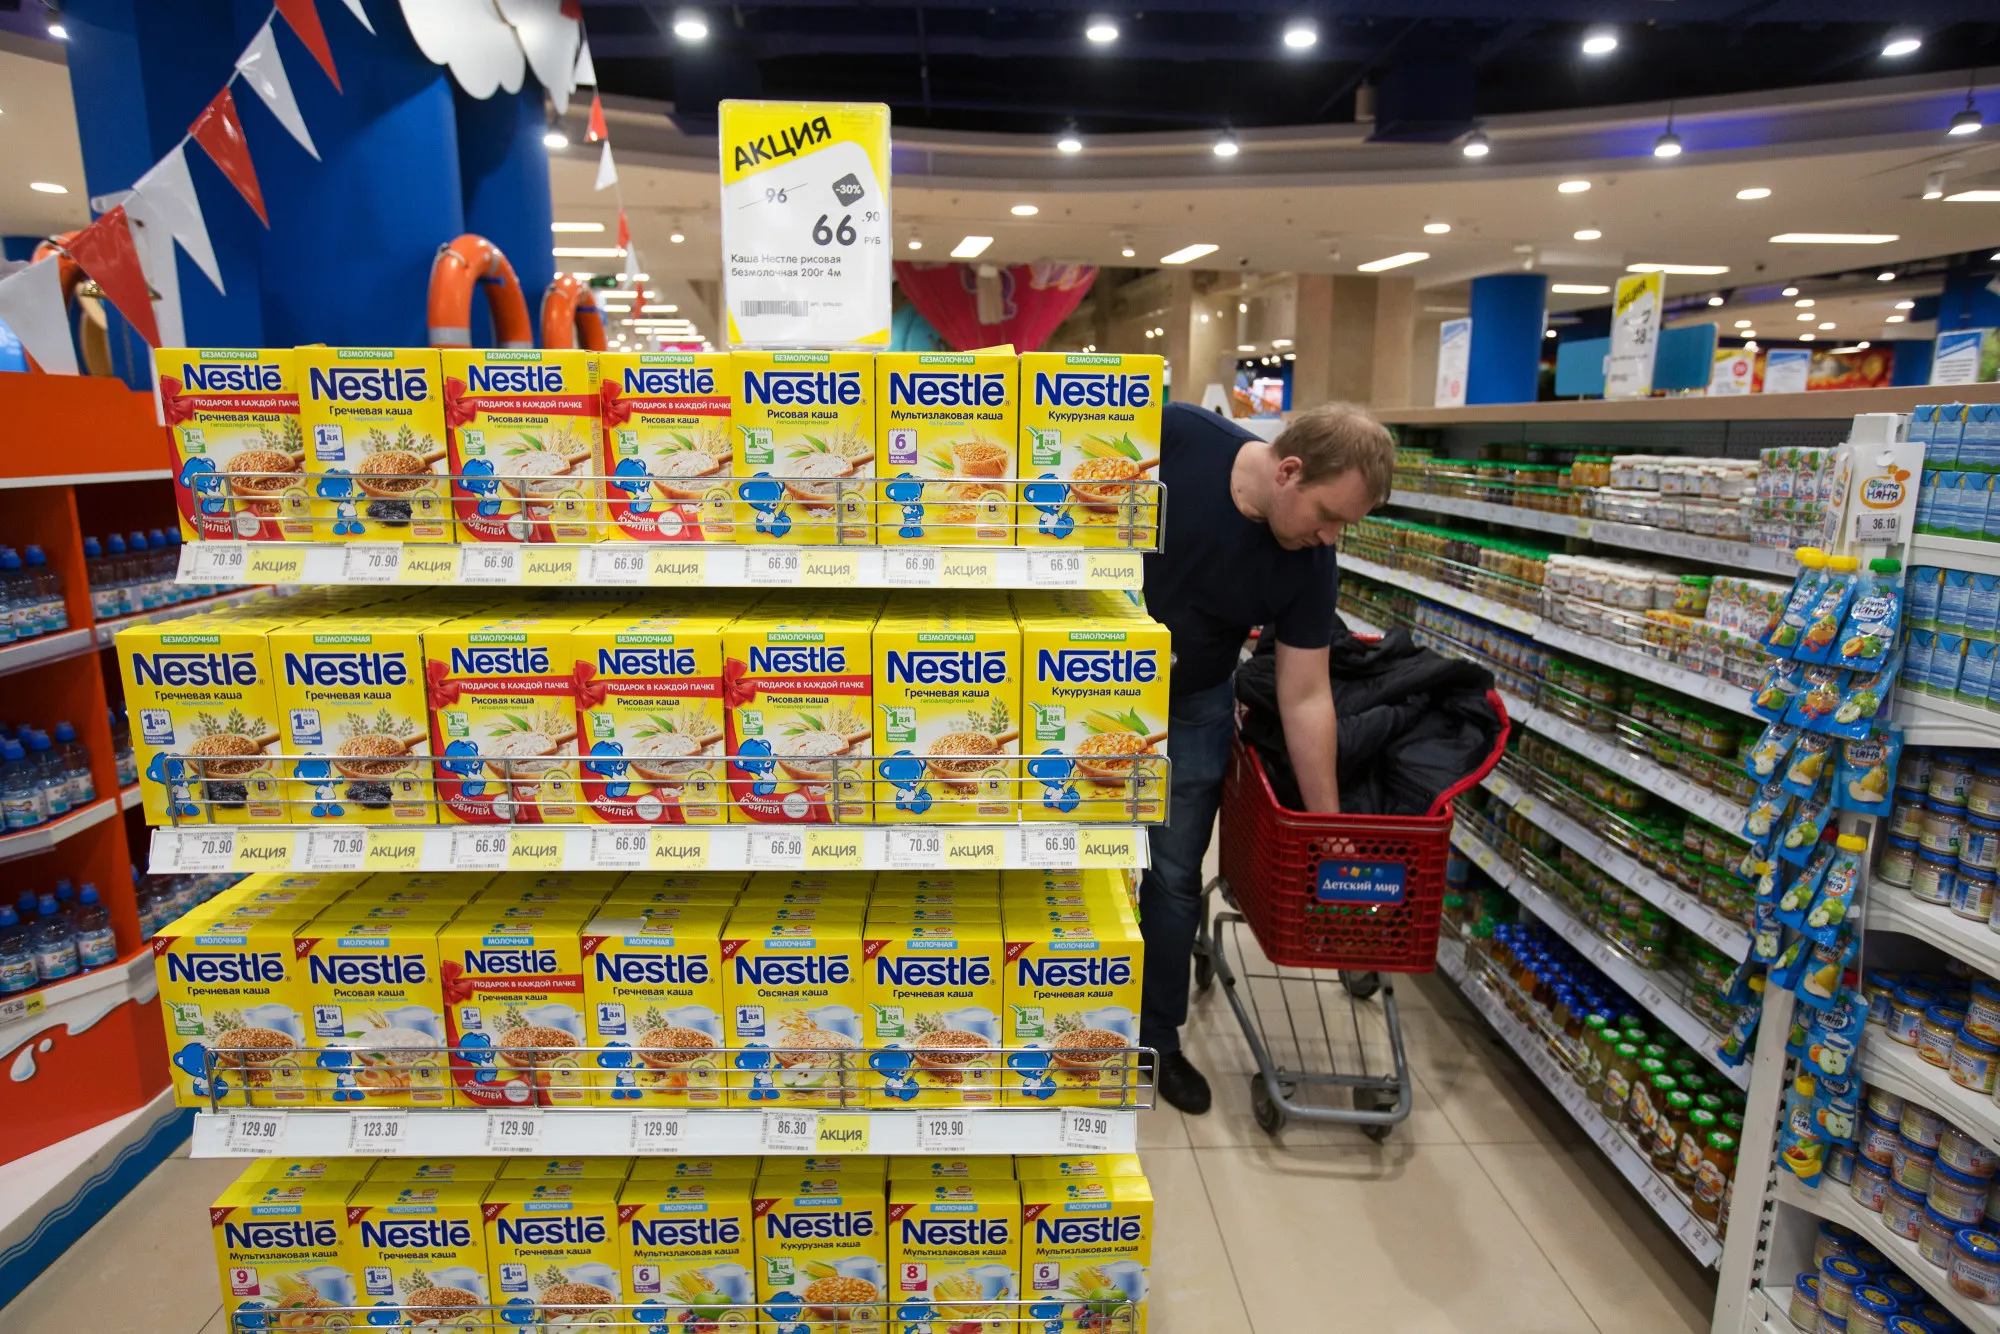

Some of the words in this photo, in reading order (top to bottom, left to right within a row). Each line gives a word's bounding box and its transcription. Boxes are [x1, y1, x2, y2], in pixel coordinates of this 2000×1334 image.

[734, 116, 832, 171] АКЦИЯ
[764, 187, 788, 203] 96
[835, 184, 861, 194] -30%
[812, 214, 857, 246] 66
[864, 236, 881, 244] РУБ
[731, 254, 759, 264] Каша
[761, 254, 798, 264] Нестле
[800, 255, 841, 266] рисовая
[731, 267, 798, 277] безмолочная
[800, 268, 824, 277] 200г
[827, 268, 842, 277] 4м
[201, 351, 257, 359] БЕЗМОЛОЧНАЯ
[486, 352, 541, 360] БЕЗМОЛОЧНАЯ
[920, 355, 974, 364] БЕЗМОЛОЧНАЯ
[182, 363, 282, 391] Nestlé
[468, 365, 563, 393] Nestlé
[624, 367, 714, 394] Nestlé
[310, 367, 428, 401] Nestlé
[744, 371, 861, 407] Nestlé
[889, 372, 1005, 407] Nestlé
[1035, 374, 1150, 408] Nestlé
[478, 400, 515, 409] ПОДАРОК
[516, 400, 521, 409] В
[522, 400, 557, 409] КАЖДОЙ
[558, 400, 583, 409] ПАЧКЕ
[329, 406, 381, 416] Гречневая
[383, 407, 413, 415] каша
[766, 409, 808, 420] Рисовая
[810, 411, 839, 419] каша
[890, 411, 975, 422] Мультизлаковая
[976, 412, 1003, 420] каша
[1048, 411, 1106, 423] Кукурузная
[1108, 412, 1135, 421] каша
[193, 412, 250, 423] Гречневая
[251, 414, 281, 422] каша
[487, 414, 523, 424] Рисовая
[525, 416, 549, 424] каша
[641, 416, 675, 424] Рисовая
[676, 416, 699, 424] каша
[1872, 518, 1896, 530] 36.10
[212, 554, 242, 566] 70.90
[252, 561, 297, 571] АКЦИЯ
[368, 555, 398, 567] 70.90
[484, 556, 514, 568] 66.90
[614, 557, 643, 570] 66.90
[768, 557, 797, 571] 66.90
[905, 557, 935, 571] 66.90
[1050, 558, 1079, 571] 66.90
[407, 561, 451, 572] АКЦИЯ
[528, 562, 572, 573] АКЦИЯ
[655, 563, 698, 574] АКЦИЯ
[806, 565, 850, 576] АКЦИЯ
[943, 565, 987, 577] АКЦИЯ
[1091, 567, 1134, 579] АКЦИЯ
[162, 635, 219, 644] БЕЗМОЛОЧНАЯ
[470, 634, 526, 642] БЕЗМОЛОЧНАЯ
[768, 633, 824, 641] БЕЗМОЛОЧНАЯ
[1070, 633, 1125, 641] БЕЗМОЛОЧНАЯ
[451, 647, 549, 674] Nestlé
[598, 648, 695, 675] Nestlé
[750, 646, 845, 673] Nestlé
[132, 652, 257, 687] Nestlé
[284, 652, 407, 686] Nestlé
[887, 650, 1006, 684] Nestlé
[1038, 649, 1157, 683] Nestlé
[607, 683, 645, 691] ПОДАРОК
[647, 683, 652, 691] В
[653, 682, 688, 691] КАЖДОЙ
[690, 683, 715, 691] ПАЧКЕ
[1052, 687, 1111, 697] Кукурузная
[1113, 688, 1141, 696] каша
[155, 691, 211, 702] Гречневая
[214, 692, 242, 700] каша
[305, 691, 361, 702] Гречневая
[363, 691, 392, 700] каша
[905, 688, 960, 698] Гречневая
[962, 689, 990, 697] каша
[471, 696, 508, 706] Рисовая
[510, 697, 534, 705] каша
[617, 697, 654, 707] Рисовая
[656, 698, 680, 706] каша
[766, 696, 803, 705] Рисовая
[805, 696, 829, 704] каша
[201, 840, 232, 855] 70.90
[332, 840, 363, 853] 70.90
[475, 839, 506, 853] 66.90
[615, 837, 646, 850] 66.90
[771, 840, 801, 855] 66.90
[909, 839, 939, 852] 70.90
[1045, 838, 1075, 851] 66.90
[240, 847, 286, 859] АКЦИЯ
[370, 846, 415, 858] АКЦИЯ
[513, 846, 557, 858] АКЦИЯ
[656, 846, 700, 858] АКЦИЯ
[811, 845, 856, 857] АКЦИЯ
[950, 845, 994, 857] АКЦИЯ
[1085, 844, 1129, 856] АКЦИЯ
[1322, 878, 1372, 891] Детский
[1374, 883, 1400, 896] мир
[488, 937, 529, 945] МОЛОЧНАЯ
[911, 941, 953, 949] МОЛОЧНАЯ
[465, 949, 557, 973] Nestlé
[167, 952, 285, 983] Nestlé
[309, 954, 426, 985] Nestlé
[596, 953, 709, 984] Nestlé
[735, 955, 850, 986] Nestlé
[877, 956, 990, 986] Nestlé
[1018, 957, 1131, 987] Nestlé
[187, 987, 241, 996] Гречневая
[242, 987, 270, 995] каша
[333, 989, 377, 998] Рисовая
[613, 987, 665, 997] Гречневая
[666, 987, 693, 996] каша
[757, 989, 800, 998] Овсяная
[802, 989, 829, 997] каша
[893, 989, 945, 1000] Гречневая
[947, 990, 974, 998] каша
[241, 1121, 277, 1137] 129.90
[363, 1122, 398, 1137] 123.30
[499, 1121, 534, 1136] 129.90
[643, 1121, 678, 1136] 129.90
[777, 1121, 807, 1136] 86.30
[929, 1121, 964, 1137] 129.90
[1072, 1118, 1107, 1134] 129.90
[819, 1129, 863, 1142] АКЦИЯ
[256, 1206, 297, 1214] МОЛОЧНАЯ
[498, 1216, 606, 1245] Nestlé
[767, 1211, 874, 1239] Nestlé
[1035, 1216, 1142, 1244] Nestlé
[224, 1220, 337, 1248] Nestlé
[361, 1220, 471, 1248] Nestlé
[632, 1217, 741, 1246] Nestlé
[902, 1218, 1008, 1245] Nestlé
[780, 1241, 834, 1251] Кукурузная
[836, 1240, 861, 1249] каша
[229, 1251, 311, 1261] Мультизлаковая
[312, 1250, 338, 1258] каша
[515, 1248, 564, 1257] Гречневая
[566, 1247, 592, 1255] каша
[902, 1248, 980, 1257] Мультизлаковая
[981, 1248, 1007, 1256] каша
